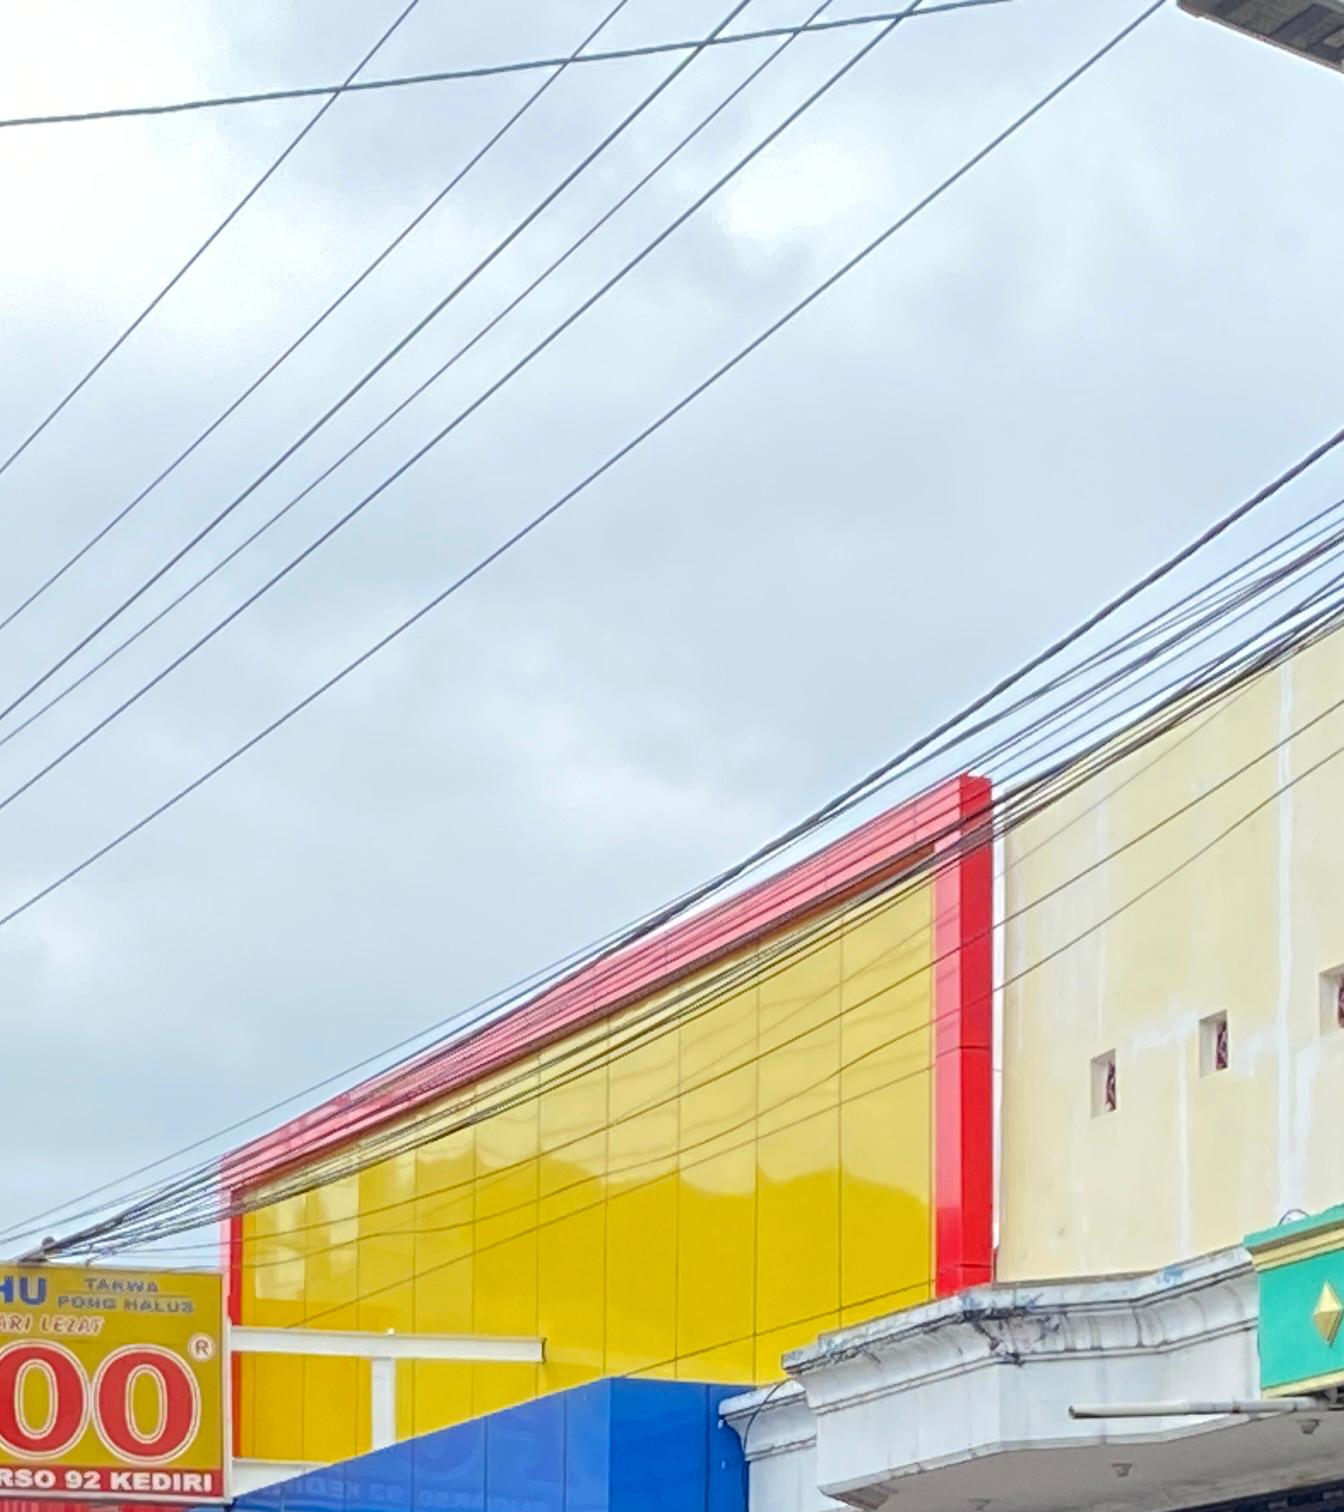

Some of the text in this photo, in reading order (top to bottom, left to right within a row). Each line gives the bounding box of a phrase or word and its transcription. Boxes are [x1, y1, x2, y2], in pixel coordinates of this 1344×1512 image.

[86, 1277, 159, 1292] TAKWA
[58, 1296, 193, 1313] PONG HALUS
[40, 1314, 105, 1335] LEZAT
[64, 1471, 101, 1491] 92
[110, 1472, 213, 1493] KEDIRI
